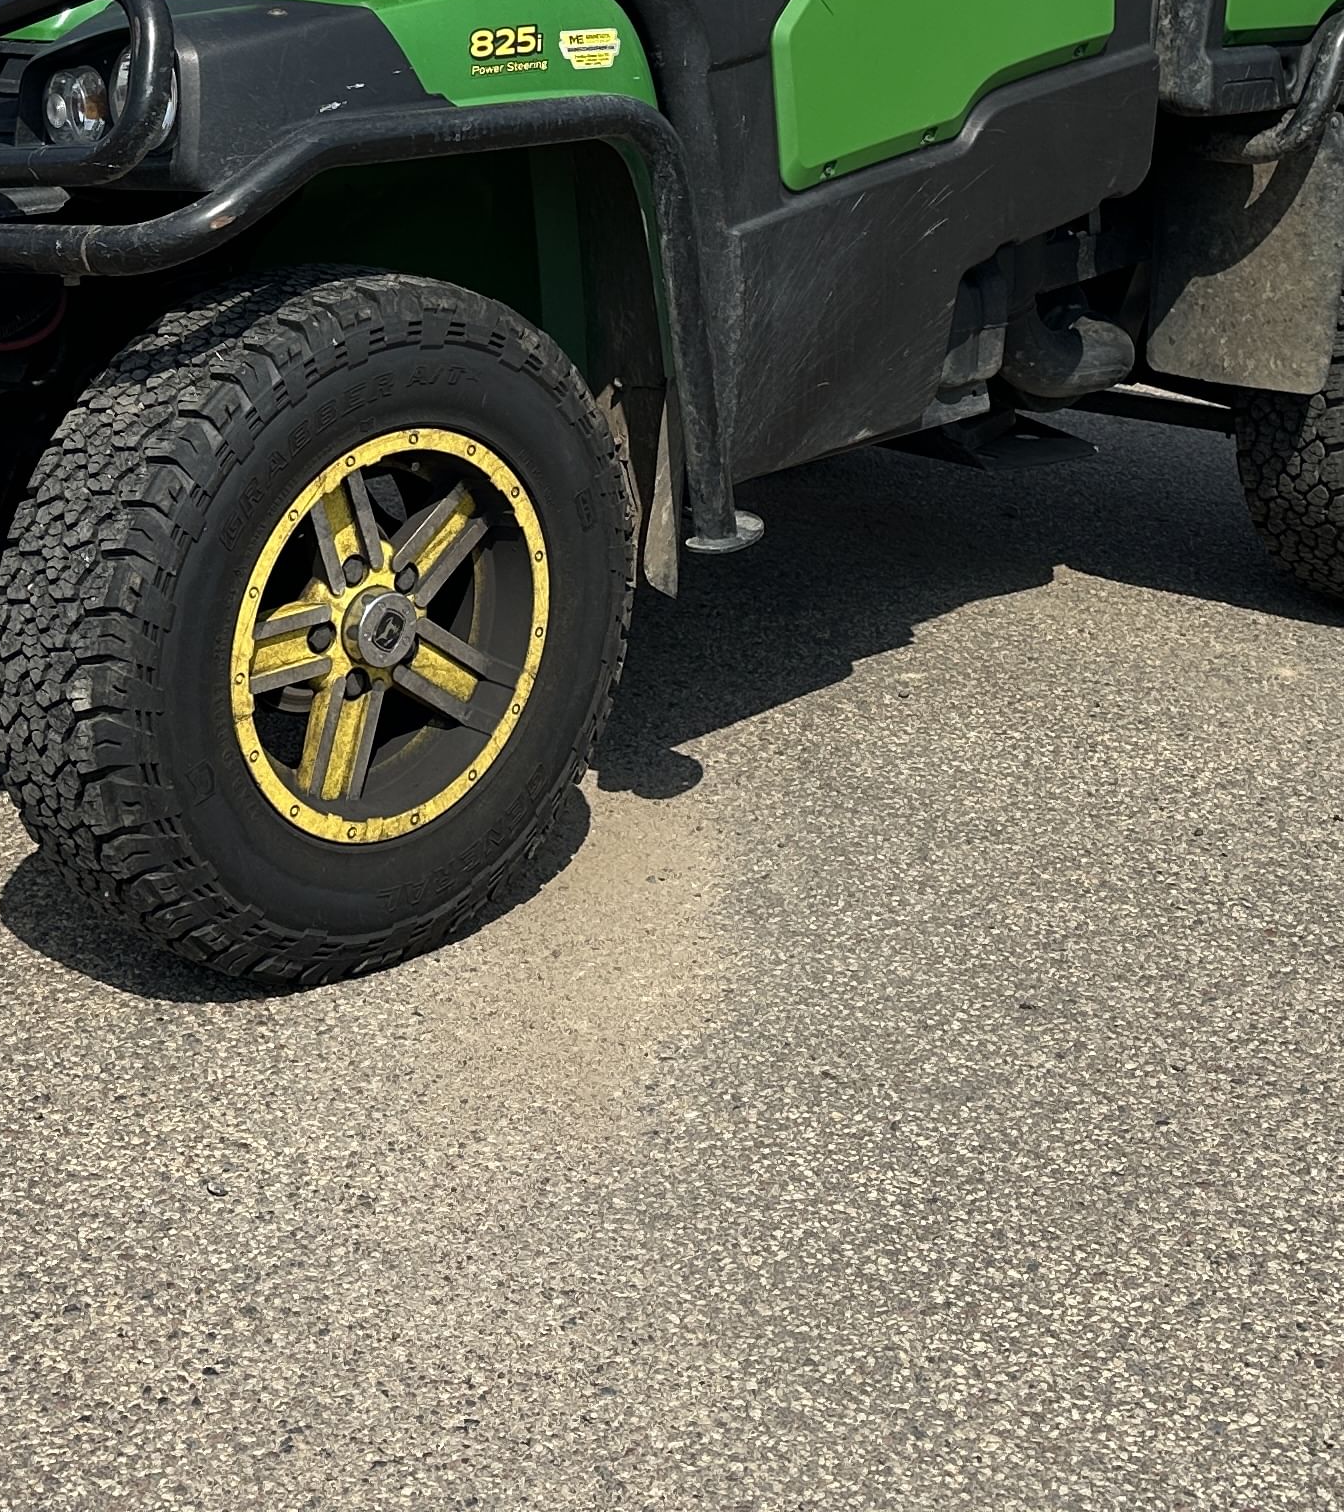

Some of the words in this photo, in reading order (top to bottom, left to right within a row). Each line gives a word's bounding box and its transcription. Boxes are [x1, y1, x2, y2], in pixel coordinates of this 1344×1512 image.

[470, 25, 542, 59] 825i
[471, 63, 504, 76] Power
[506, 59, 548, 72] Steering
[219, 372, 394, 552] GRABBER
[376, 762, 551, 913] GENERAL
